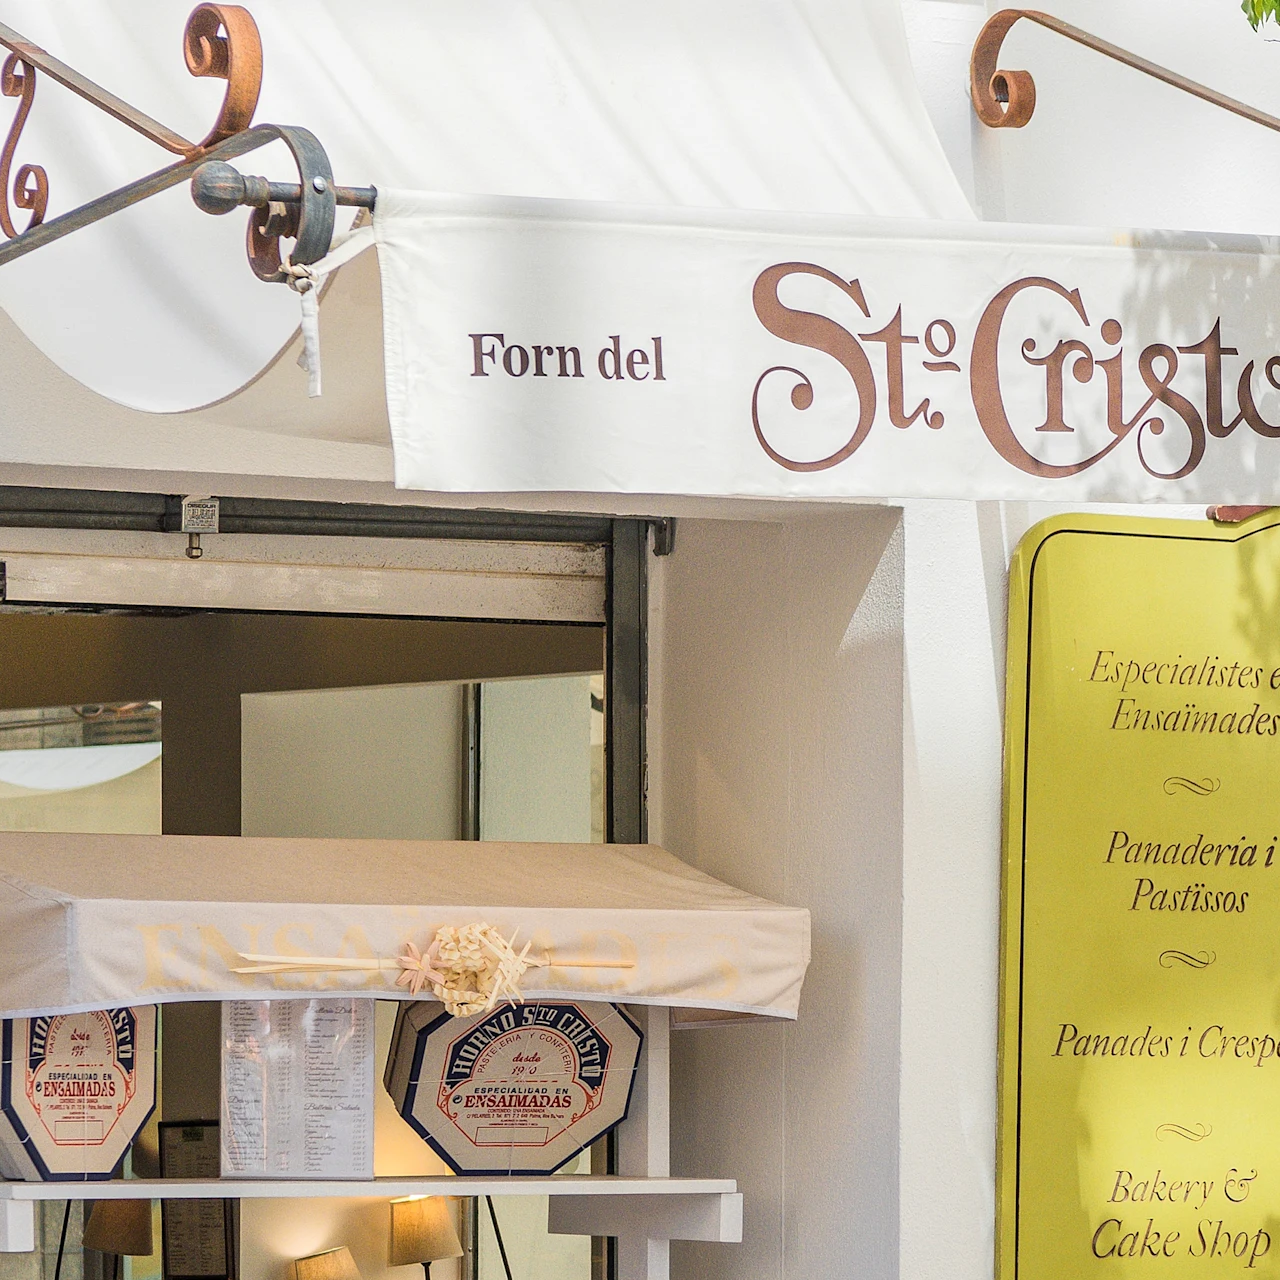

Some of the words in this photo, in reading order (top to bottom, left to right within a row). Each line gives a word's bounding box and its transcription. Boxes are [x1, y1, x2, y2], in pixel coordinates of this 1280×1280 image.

[469, 333, 585, 378] Forn
[598, 335, 667, 381] del
[1086, 650, 1263, 692] Especialistes
[1102, 830, 1257, 866] Panadería
[1263, 835, 1279, 868] i
[451, 1009, 516, 1075] HORNO
[556, 1012, 602, 1078] CRISTO
[1051, 1023, 1173, 1057] Panades
[1179, 1026, 1192, 1056] i
[43, 1081, 116, 1097] ENSAIMADAS
[48, 1072, 98, 1081] ESPECIALIDAD
[102, 1073, 112, 1081] EN
[474, 1087, 548, 1095] ESPECIALIDAD
[556, 1087, 569, 1095] EN
[463, 1094, 573, 1108] ENSAIMADAS
[1107, 1170, 1214, 1210] Bakery
[1223, 1168, 1258, 1202] &
[1091, 1218, 1180, 1259] Cake
[1188, 1219, 1272, 1268] Shop
